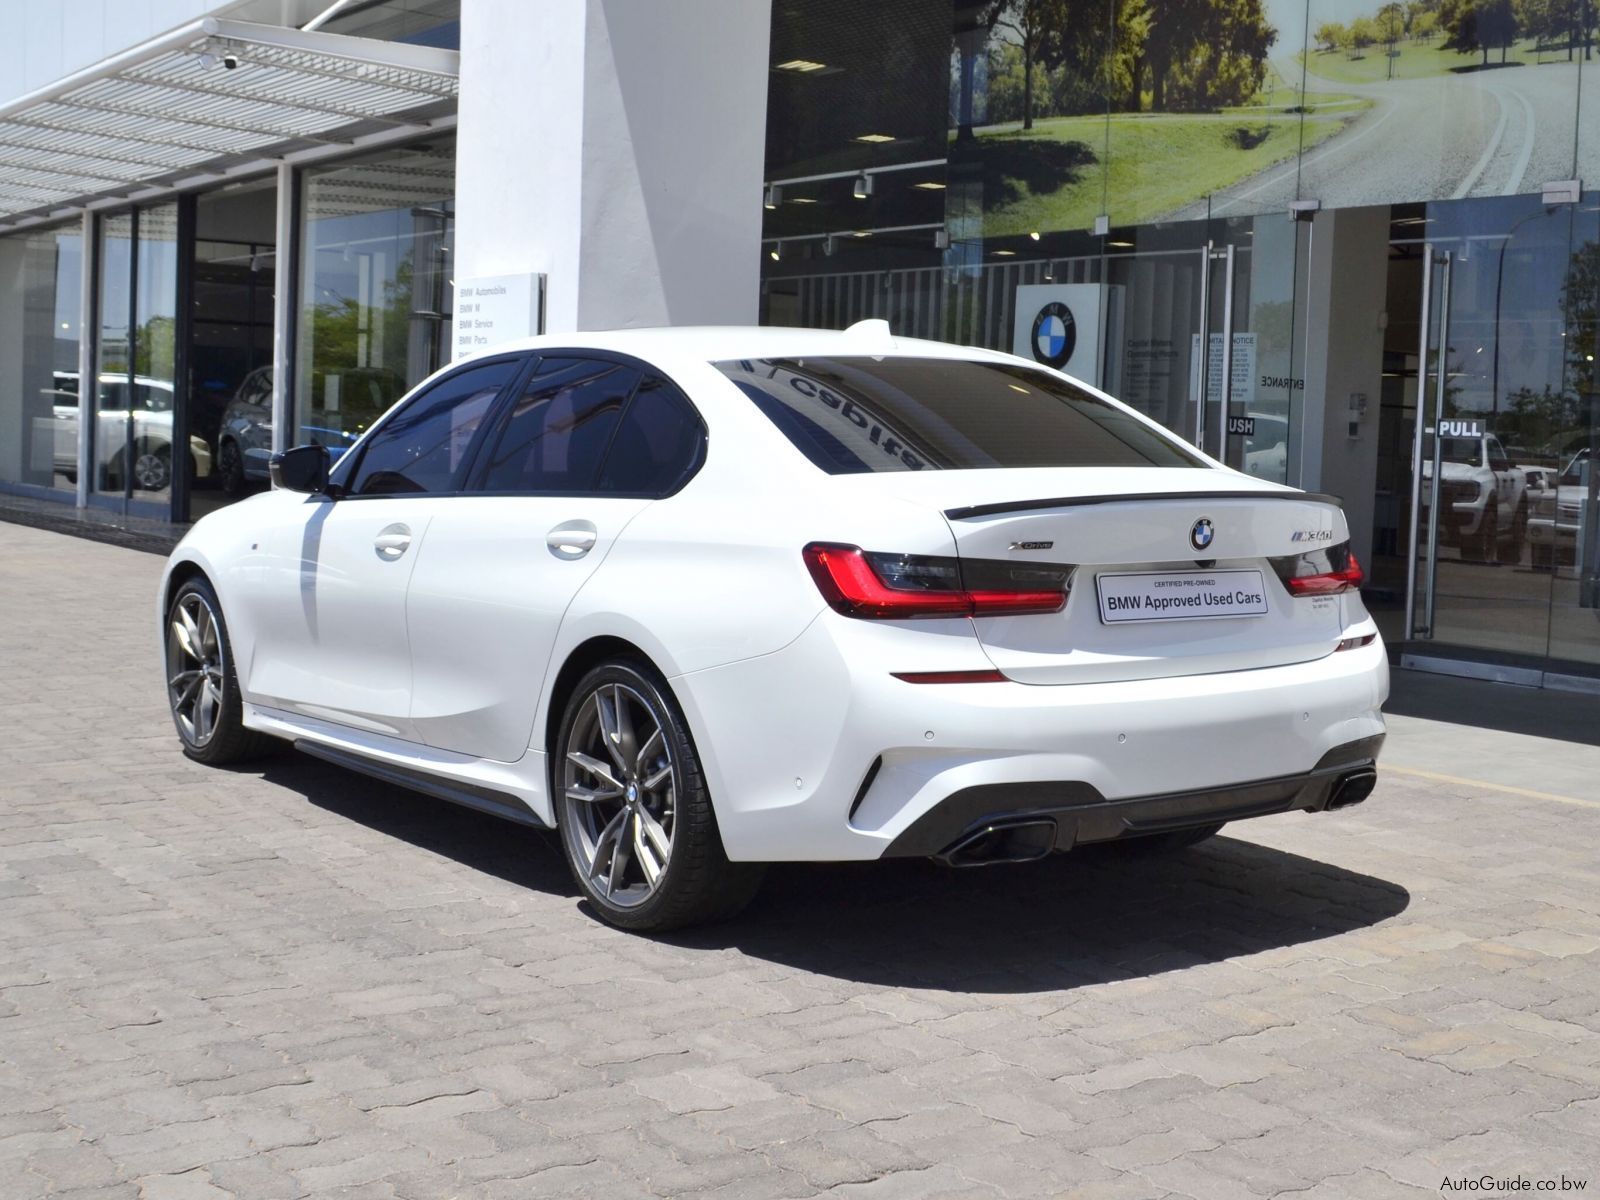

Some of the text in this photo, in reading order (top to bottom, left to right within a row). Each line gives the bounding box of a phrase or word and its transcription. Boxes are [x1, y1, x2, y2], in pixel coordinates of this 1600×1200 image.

[460, 288, 473, 297] BMW
[460, 305, 473, 313] BMW
[459, 320, 472, 329] BMW
[459, 336, 472, 344] BMW
[1229, 418, 1253, 433] USH
[1439, 421, 1481, 437] PULL
[1183, 579, 1216, 587] PRE-OWNED
[1108, 591, 1262, 611] BMW Approved Used Cars
